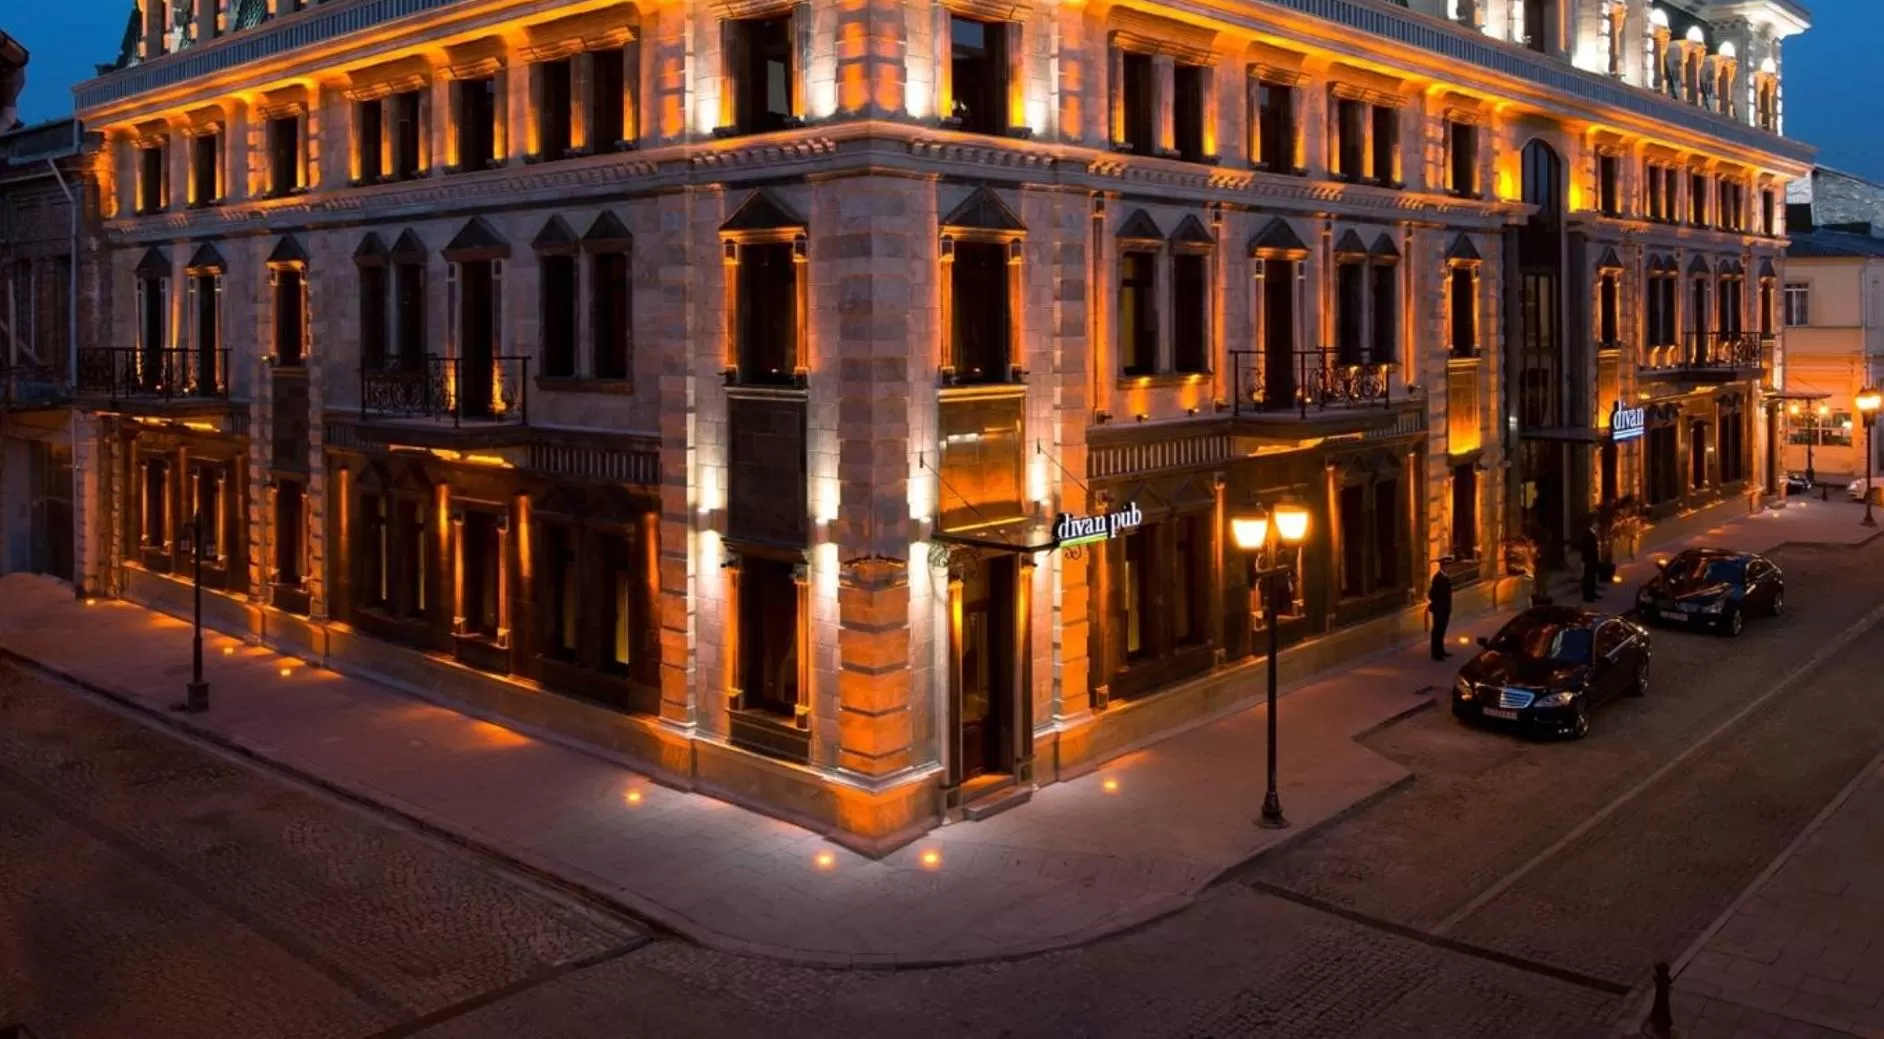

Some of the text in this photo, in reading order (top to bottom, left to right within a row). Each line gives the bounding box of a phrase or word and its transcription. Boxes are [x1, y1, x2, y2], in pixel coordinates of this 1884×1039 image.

[1613, 400, 1644, 430] divan
[1058, 501, 1142, 538] divan pub
